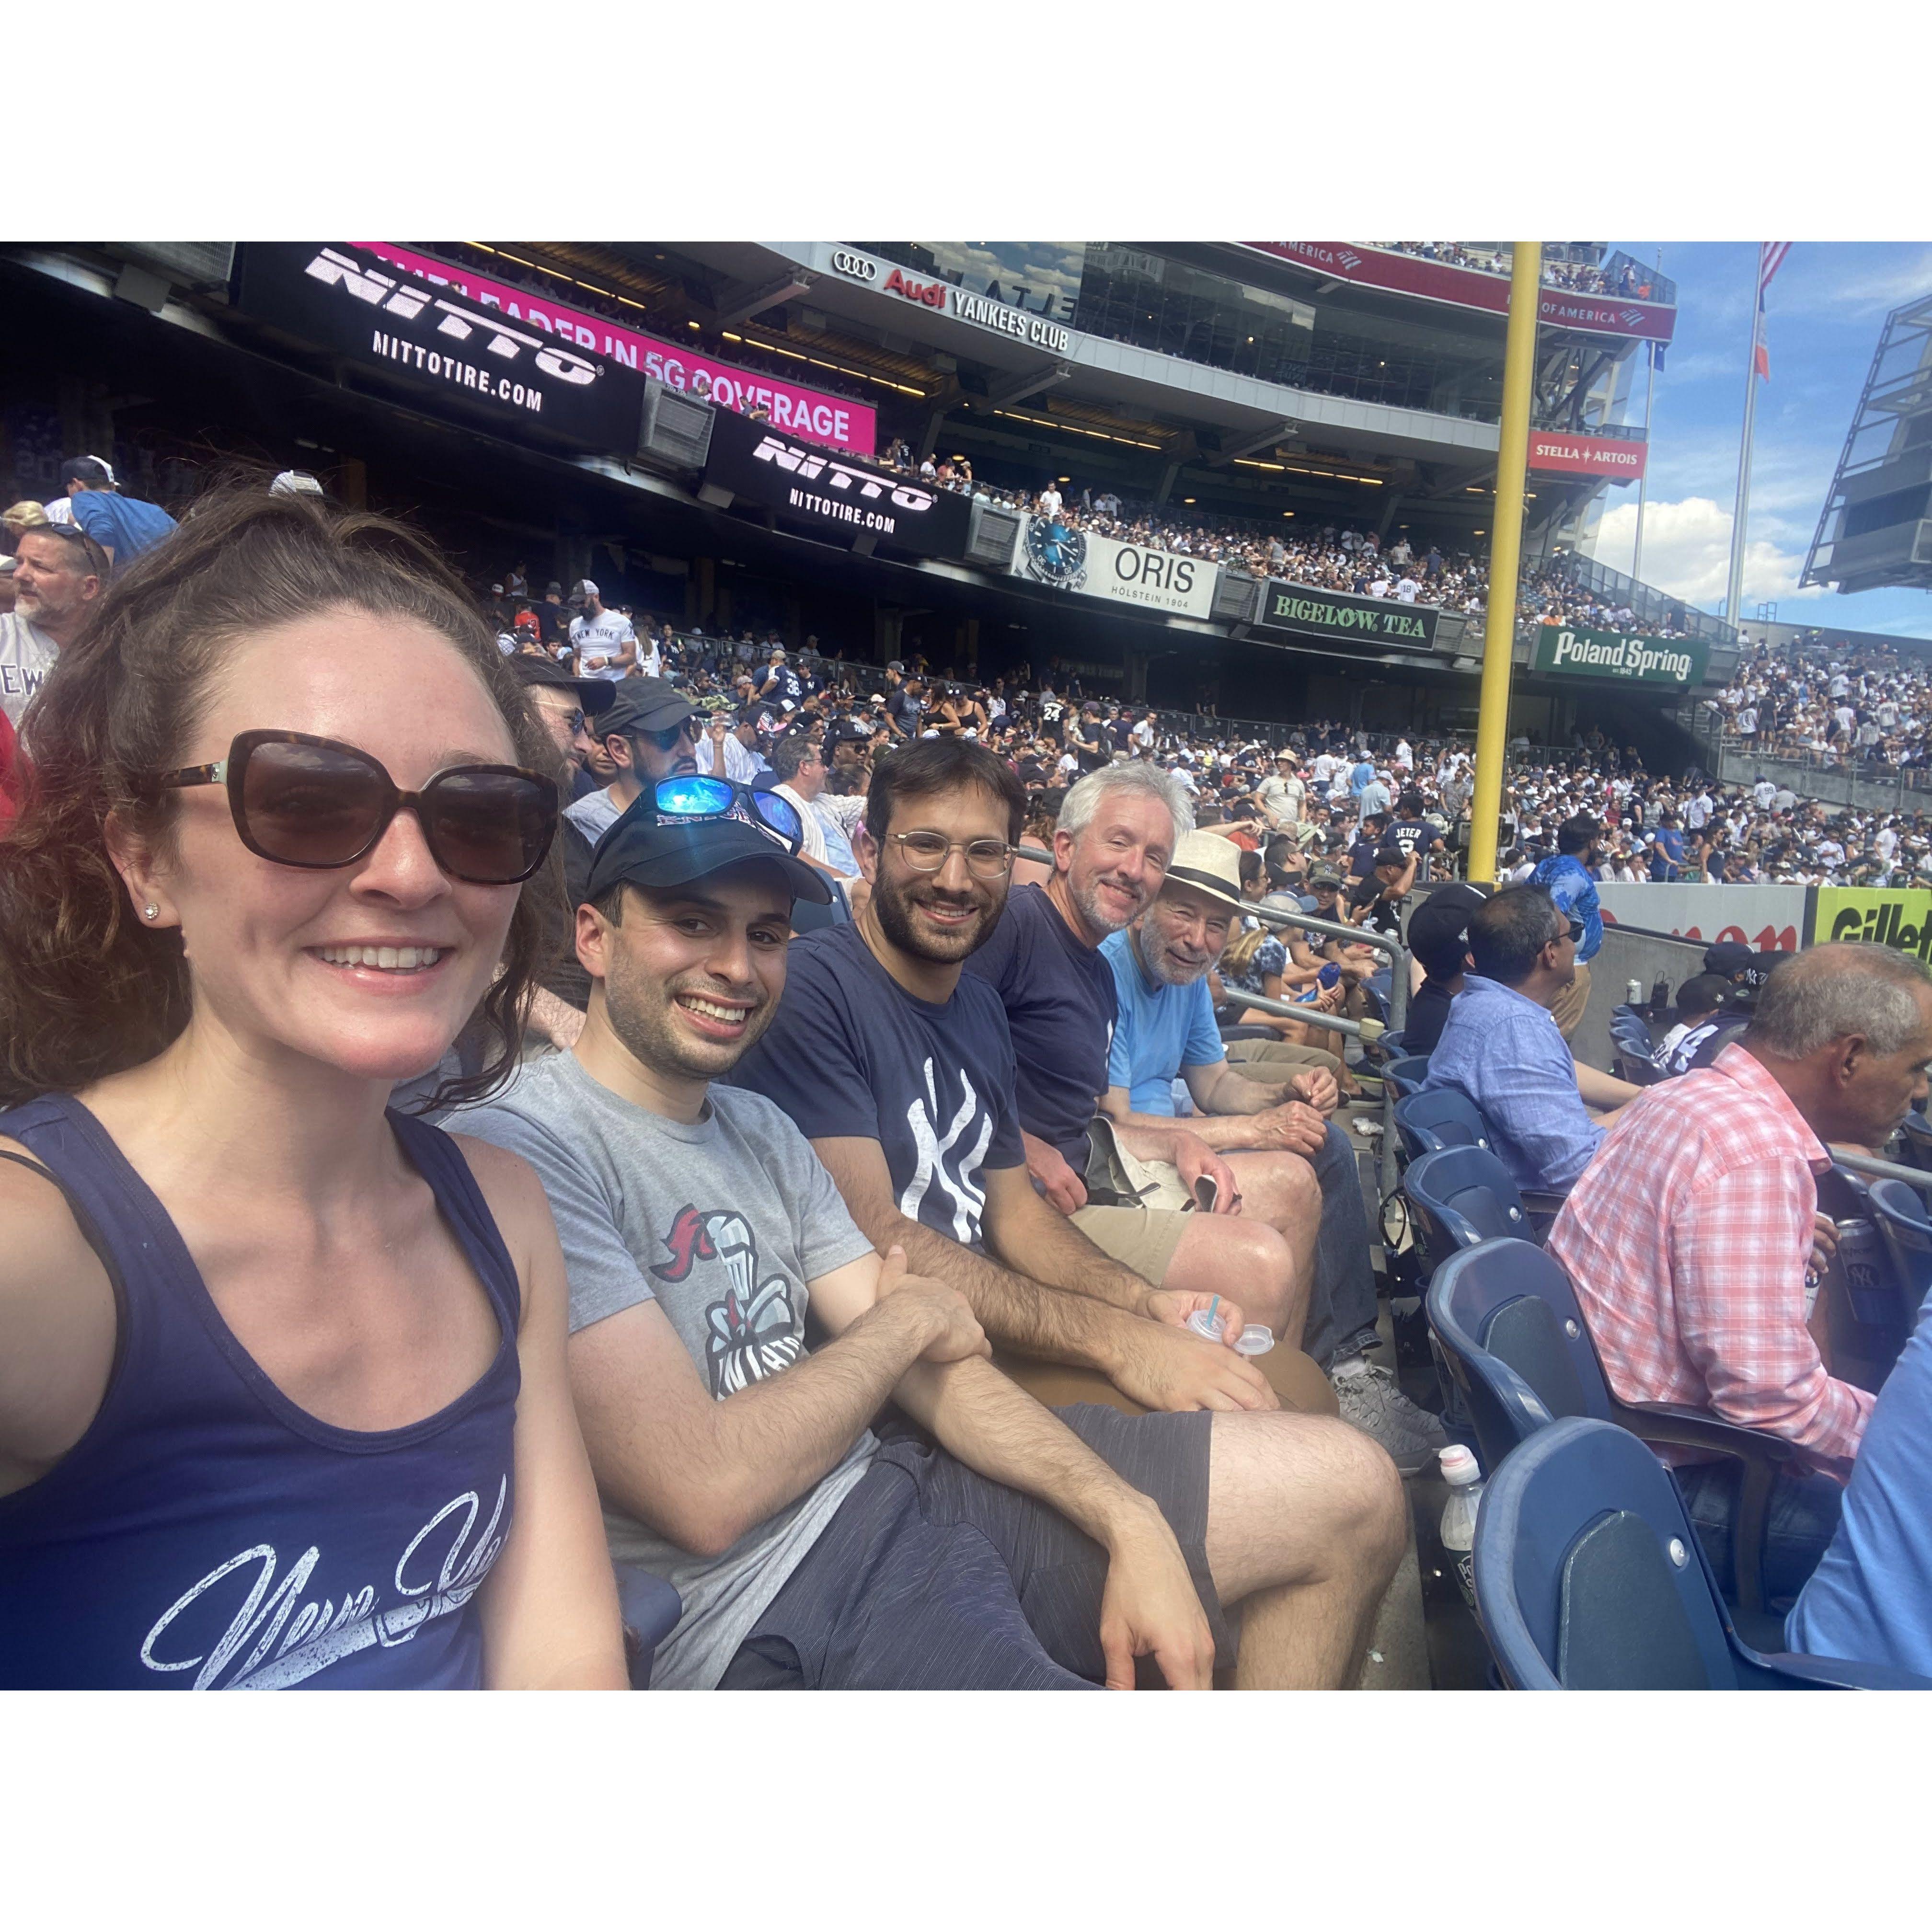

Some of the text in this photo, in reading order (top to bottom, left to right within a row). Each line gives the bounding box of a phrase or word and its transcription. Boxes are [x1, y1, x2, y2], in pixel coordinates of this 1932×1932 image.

[1278, 241, 1334, 264] AMERICA
[305, 247, 596, 385] NITTO
[884, 269, 1069, 352] Audi YANKEES CLUB
[1541, 302, 1616, 324] OF AMERICA
[373, 331, 543, 412] NITTOTIRE.COM
[605, 335, 637, 369] IN
[645, 351, 686, 390] 5G
[692, 369, 850, 442] COVERAGE
[753, 436, 932, 511] NITTO
[1536, 445, 1637, 465] STELLA ARTOIS
[790, 488, 896, 533] NITTOTIRE.COM
[1116, 548, 1195, 593] ORIS
[1166, 598, 1188, 608] 1904
[1273, 595, 1426, 638] BIGELOW TEA
[575, 628, 613, 640] NEW YORK
[1552, 632, 1691, 681] Poland Spring
[1044, 708, 1059, 721] 24
[1396, 828, 1422, 838] JETER
[717, 1336, 800, 1402] NIHT
[140, 1544, 381, 1690] New
